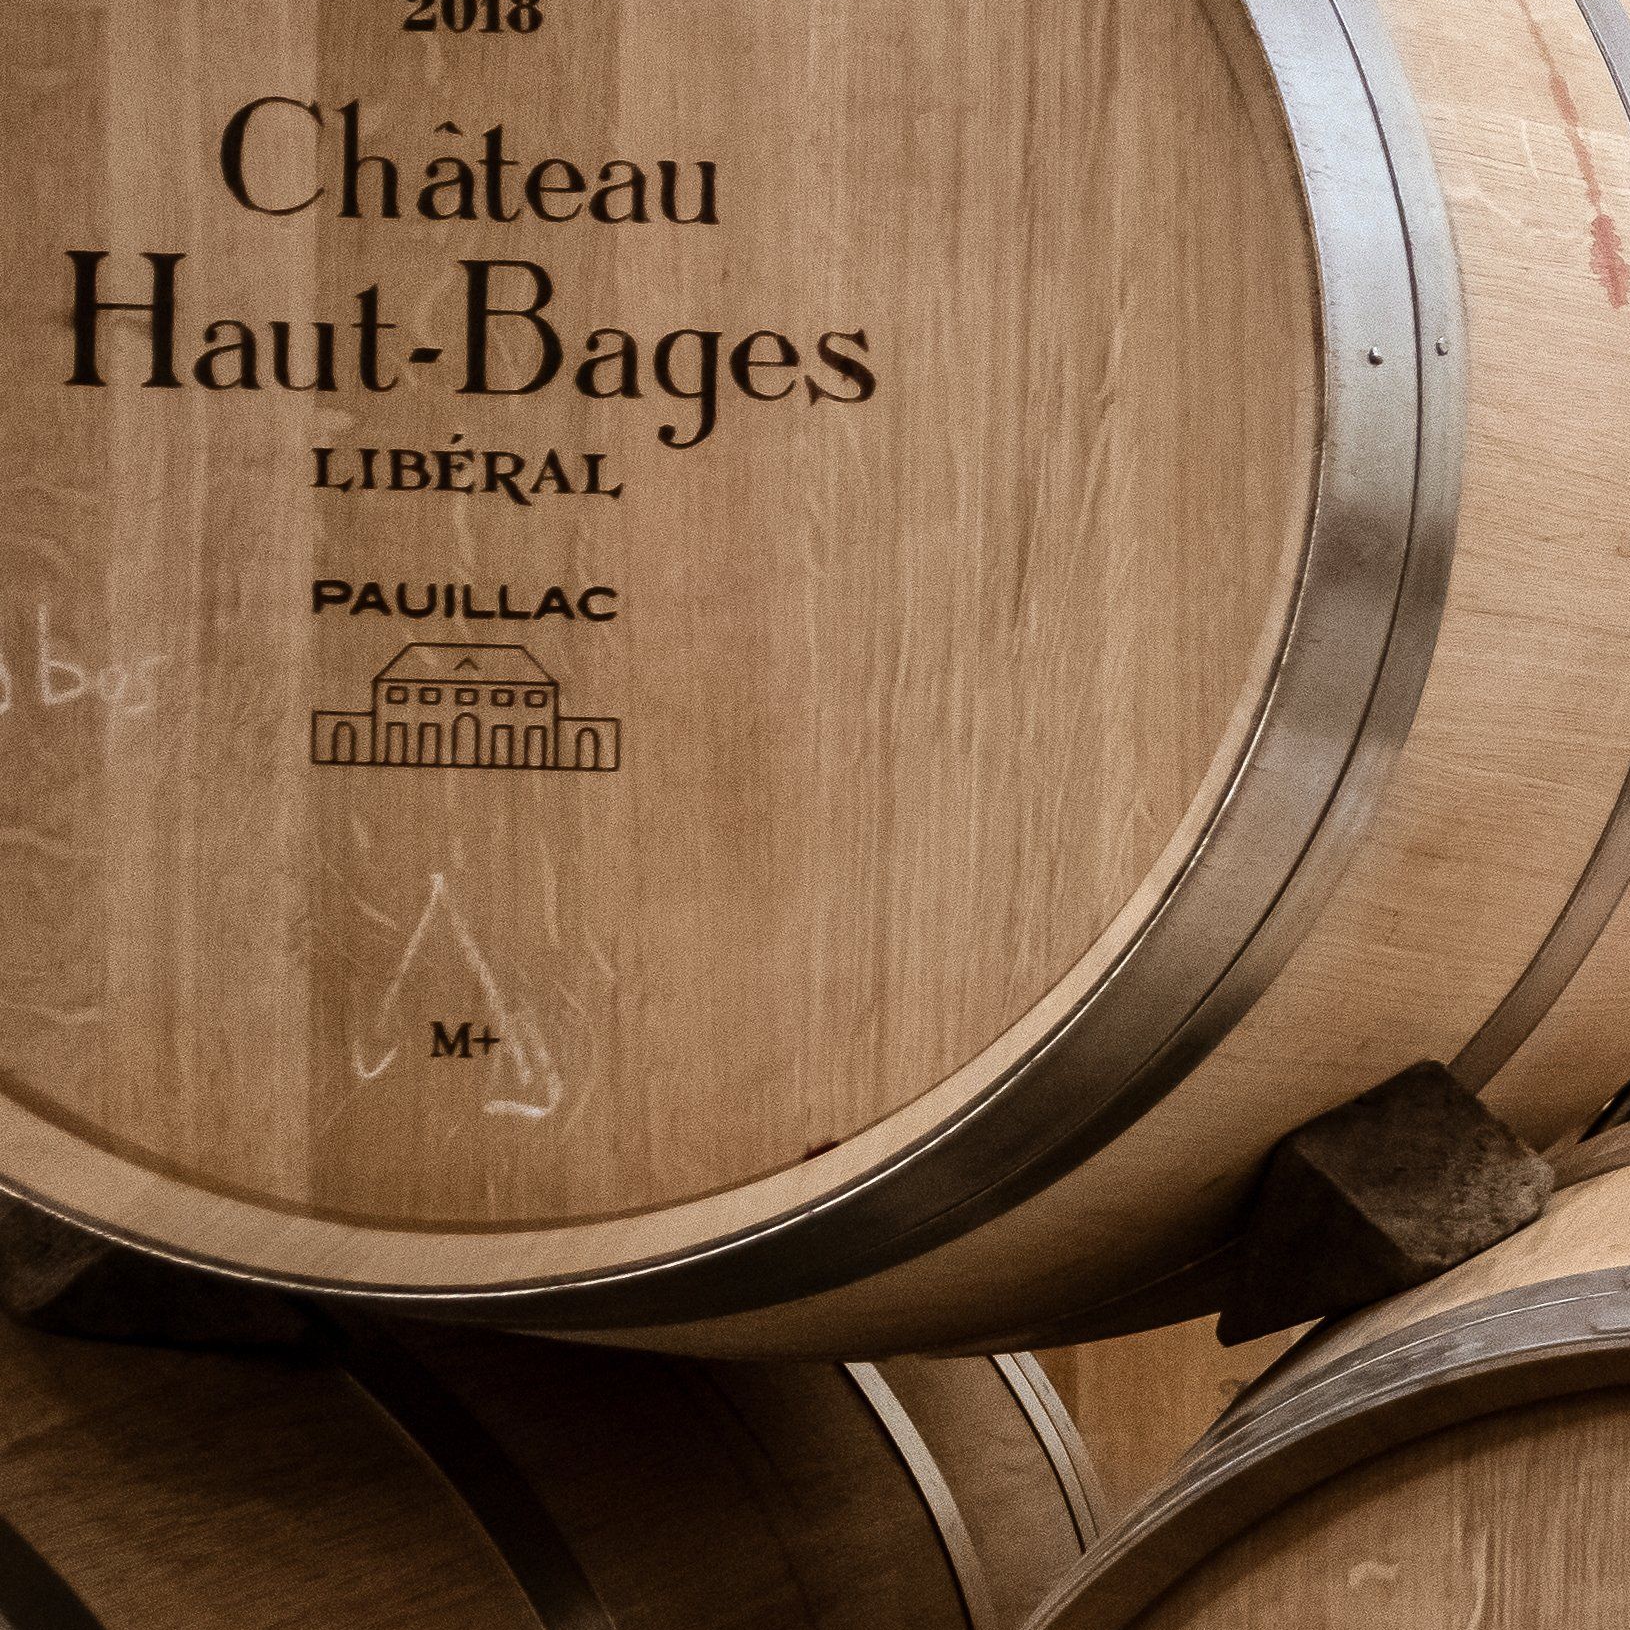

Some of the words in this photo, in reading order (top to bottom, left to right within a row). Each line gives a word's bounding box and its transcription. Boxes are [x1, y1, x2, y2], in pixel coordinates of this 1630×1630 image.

[220, 96, 718, 225] Château
[63, 249, 876, 450] Haut-Bages
[313, 434, 622, 506] LIBÉRAL
[312, 579, 617, 622] PAUILLAC
[431, 1021, 498, 1059] M+
